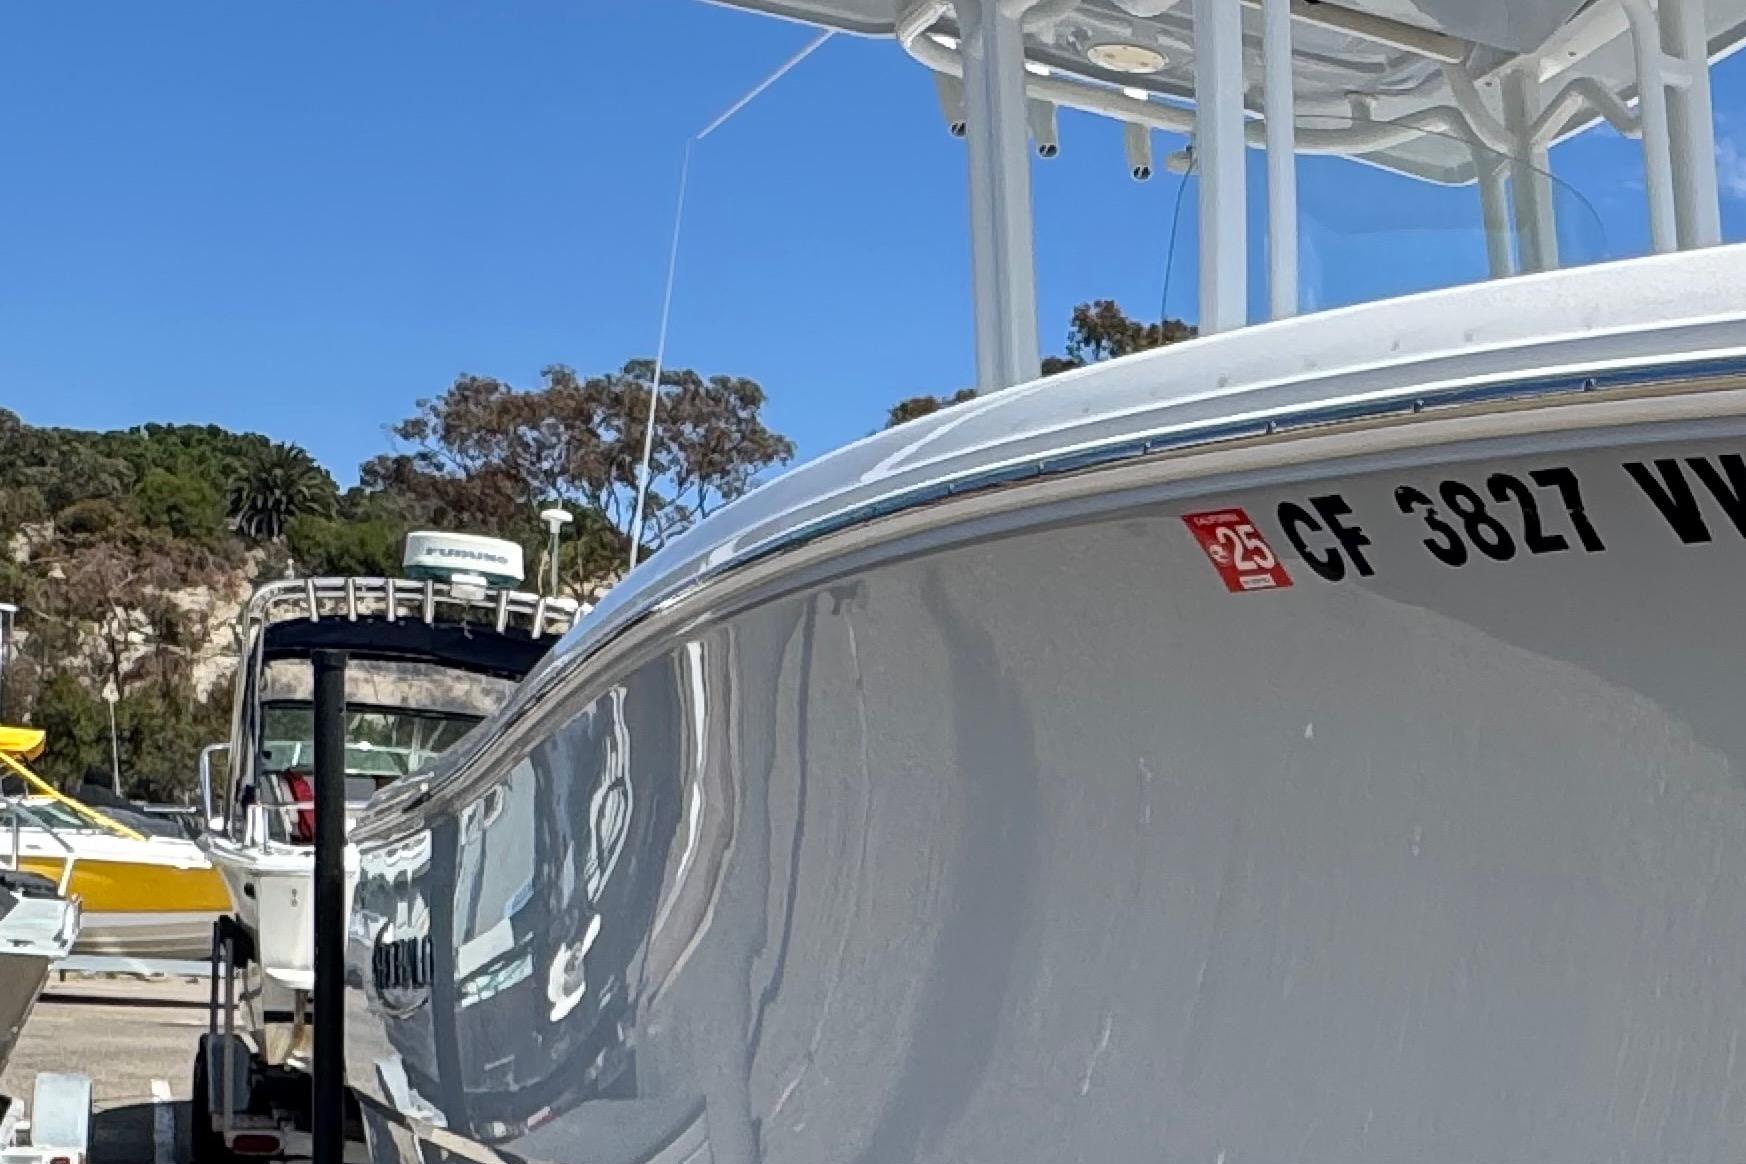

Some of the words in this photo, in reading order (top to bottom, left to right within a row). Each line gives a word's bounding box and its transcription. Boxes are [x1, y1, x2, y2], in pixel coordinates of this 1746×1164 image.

[1215, 524, 1275, 570] 25
[1277, 493, 1375, 582] CF
[1393, 466, 1606, 567] 3827
